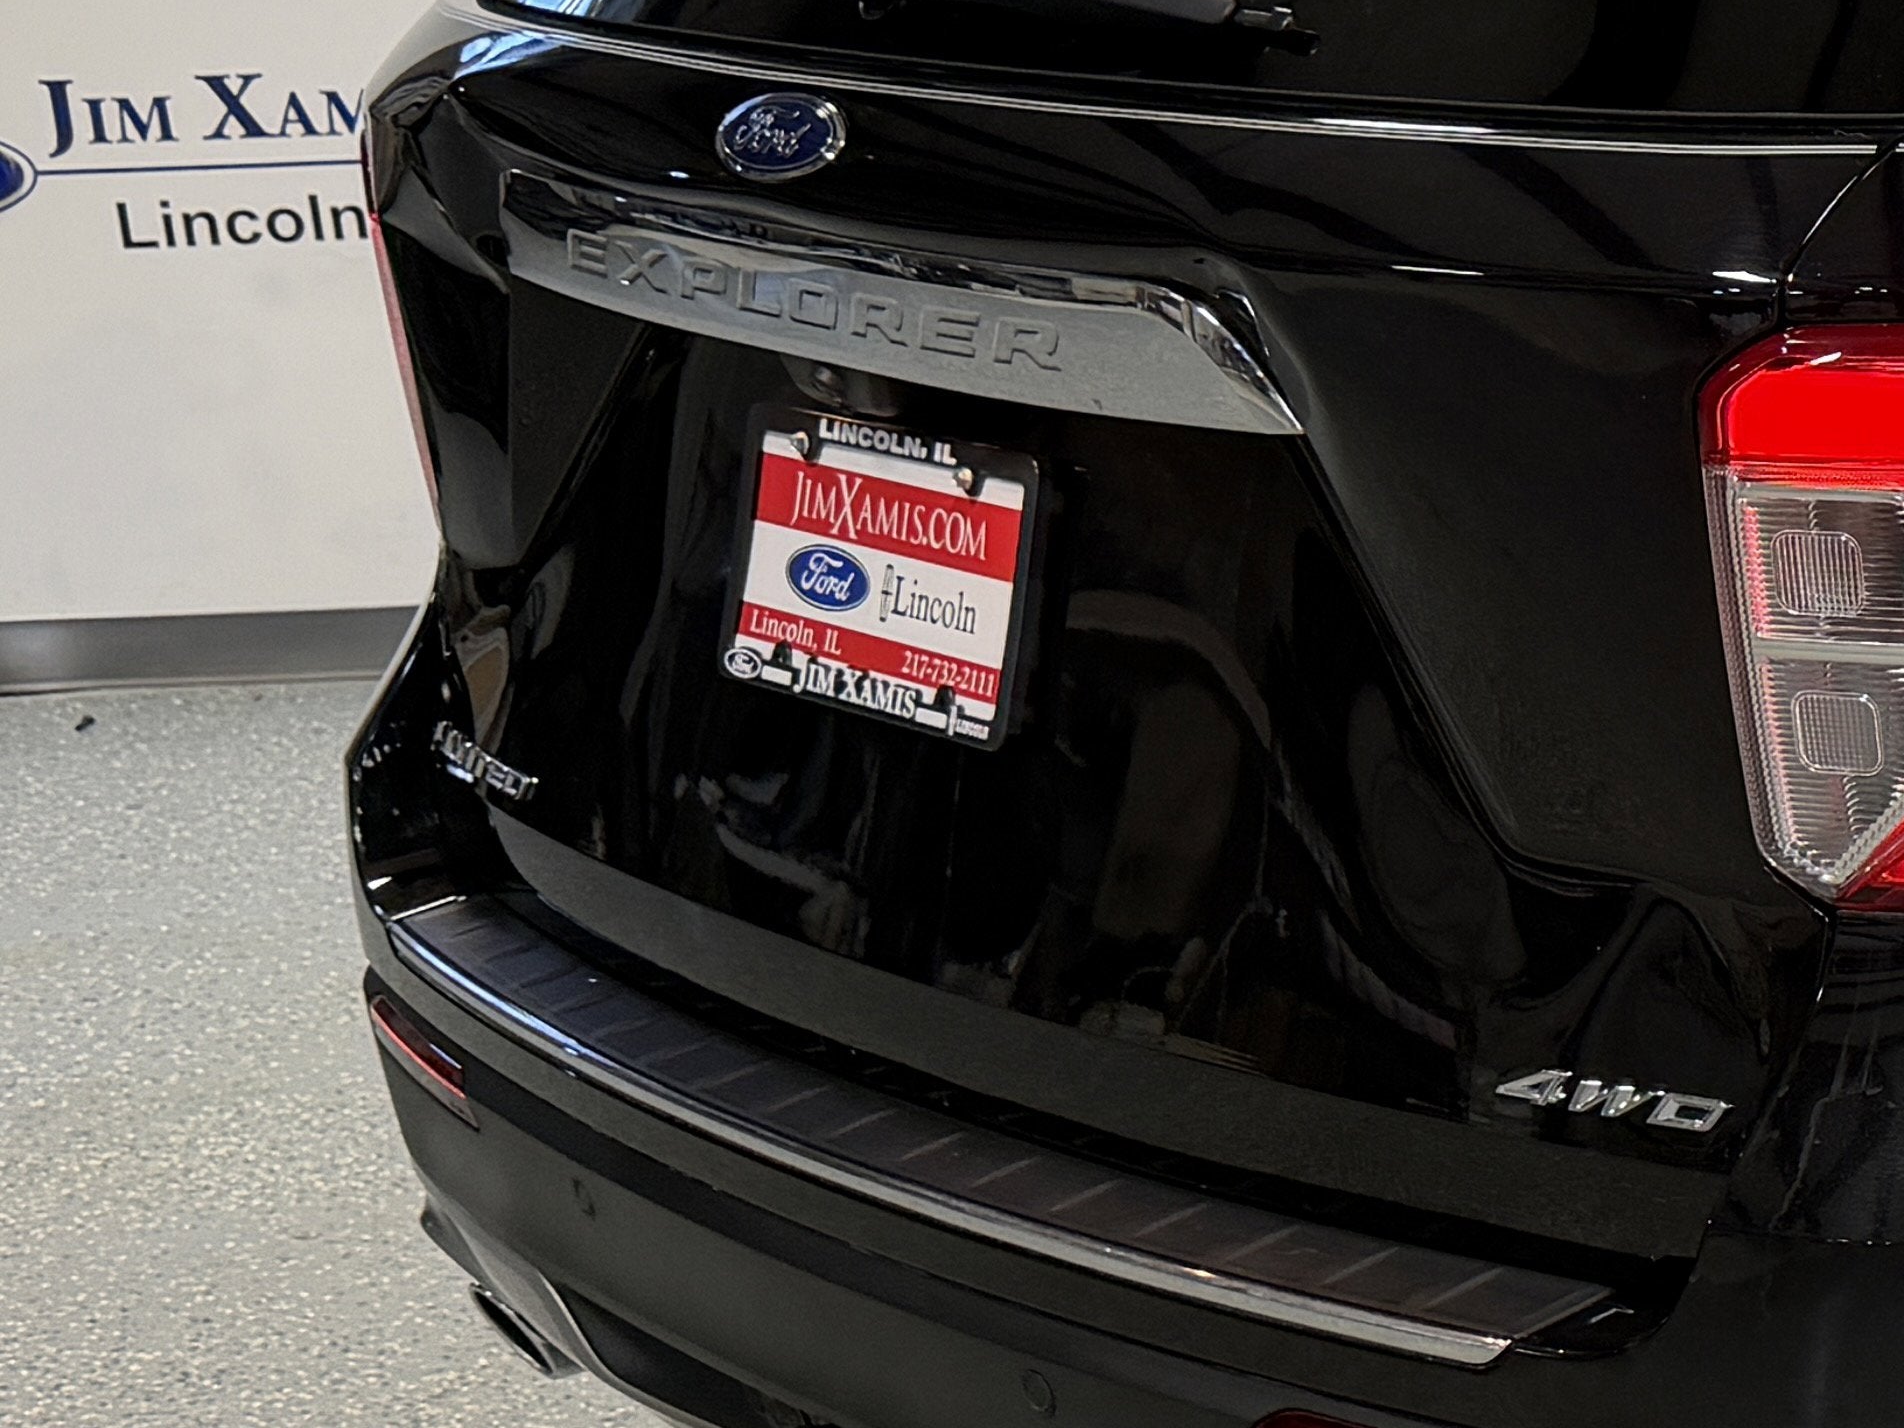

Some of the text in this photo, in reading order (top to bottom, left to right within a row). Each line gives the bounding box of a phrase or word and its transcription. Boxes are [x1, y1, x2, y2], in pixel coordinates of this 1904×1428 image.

[38, 73, 364, 159] JIM XAM
[733, 104, 812, 159] Ford
[566, 227, 1063, 372] EXPLORER
[818, 418, 957, 466] LINCOLN, IL
[789, 470, 987, 561] JIMXAMIS.COM
[800, 552, 854, 602] Ford
[891, 575, 977, 634] Lincoln
[749, 608, 842, 656] Lincoln, IL
[792, 661, 918, 720] JIM XAMIS
[901, 650, 996, 698] 217-732-2111
[1496, 1069, 1735, 1132] 4WD
